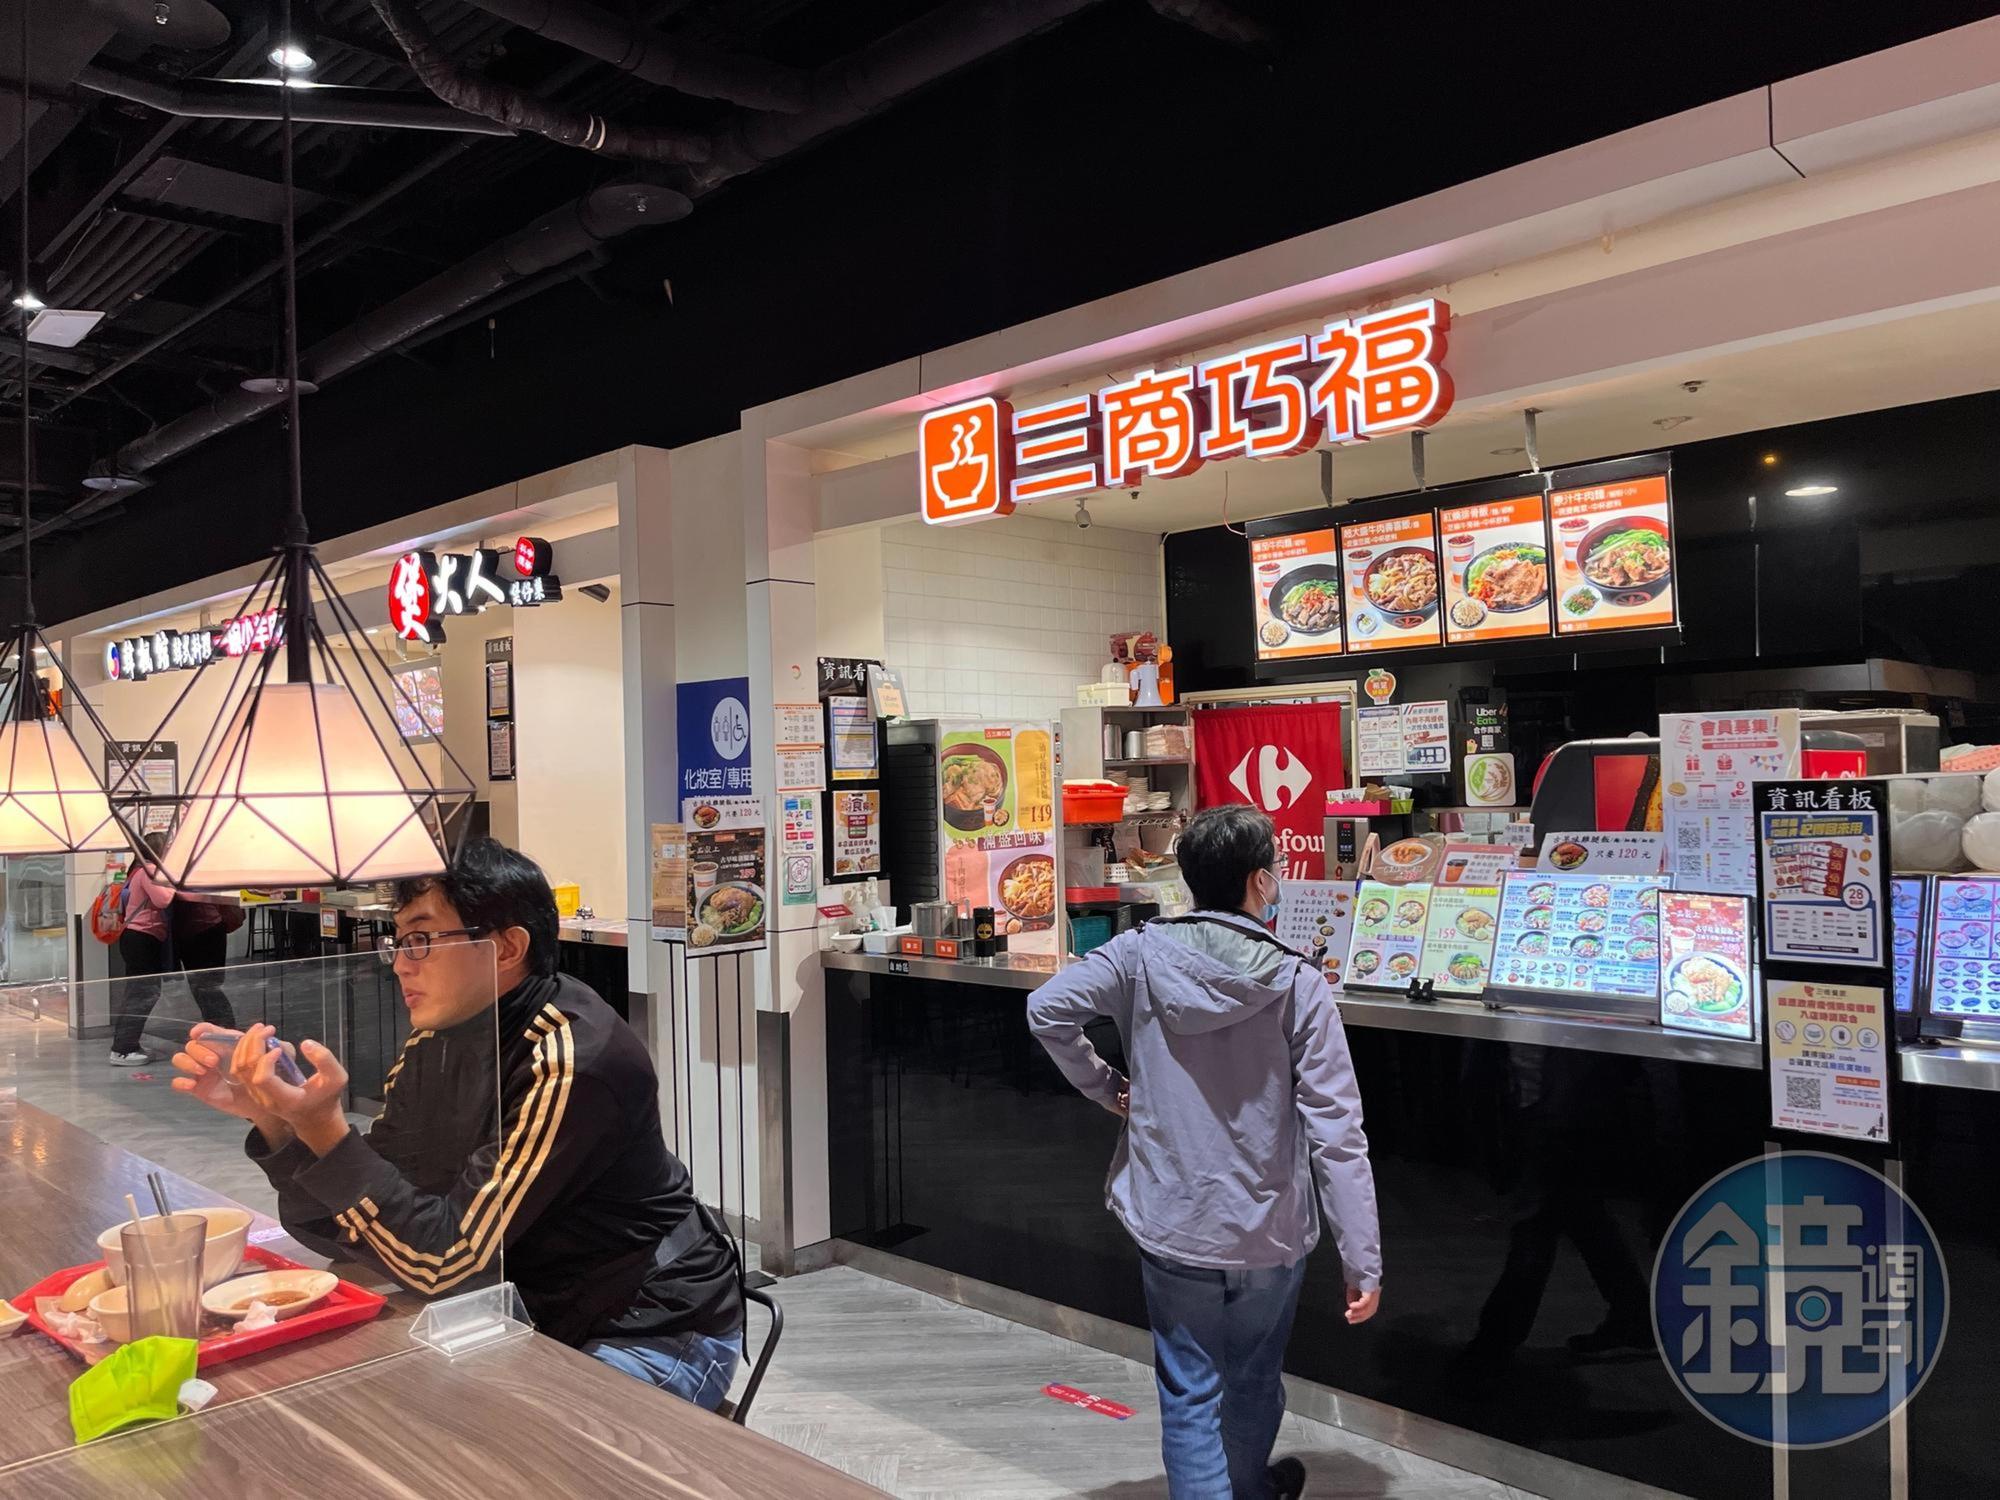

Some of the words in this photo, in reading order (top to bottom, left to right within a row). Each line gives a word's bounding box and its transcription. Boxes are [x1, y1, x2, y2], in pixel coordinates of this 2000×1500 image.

[1010, 297, 1443, 503] 三商巧福
[1476, 707, 1498, 716] Uber
[1476, 716, 1498, 725] Eats
[121, 743, 164, 754] 資訊板
[684, 767, 752, 790] 化妝室/專用
[1767, 786, 1876, 811] 資訊看板
[740, 808, 753, 817] 120
[1031, 804, 1053, 823] 149
[1595, 849, 1615, 858] 只要
[1618, 848, 1638, 859] 120
[1641, 851, 1652, 859] 元
[1849, 888, 1864, 899] 28
[1438, 928, 1457, 939] 159
